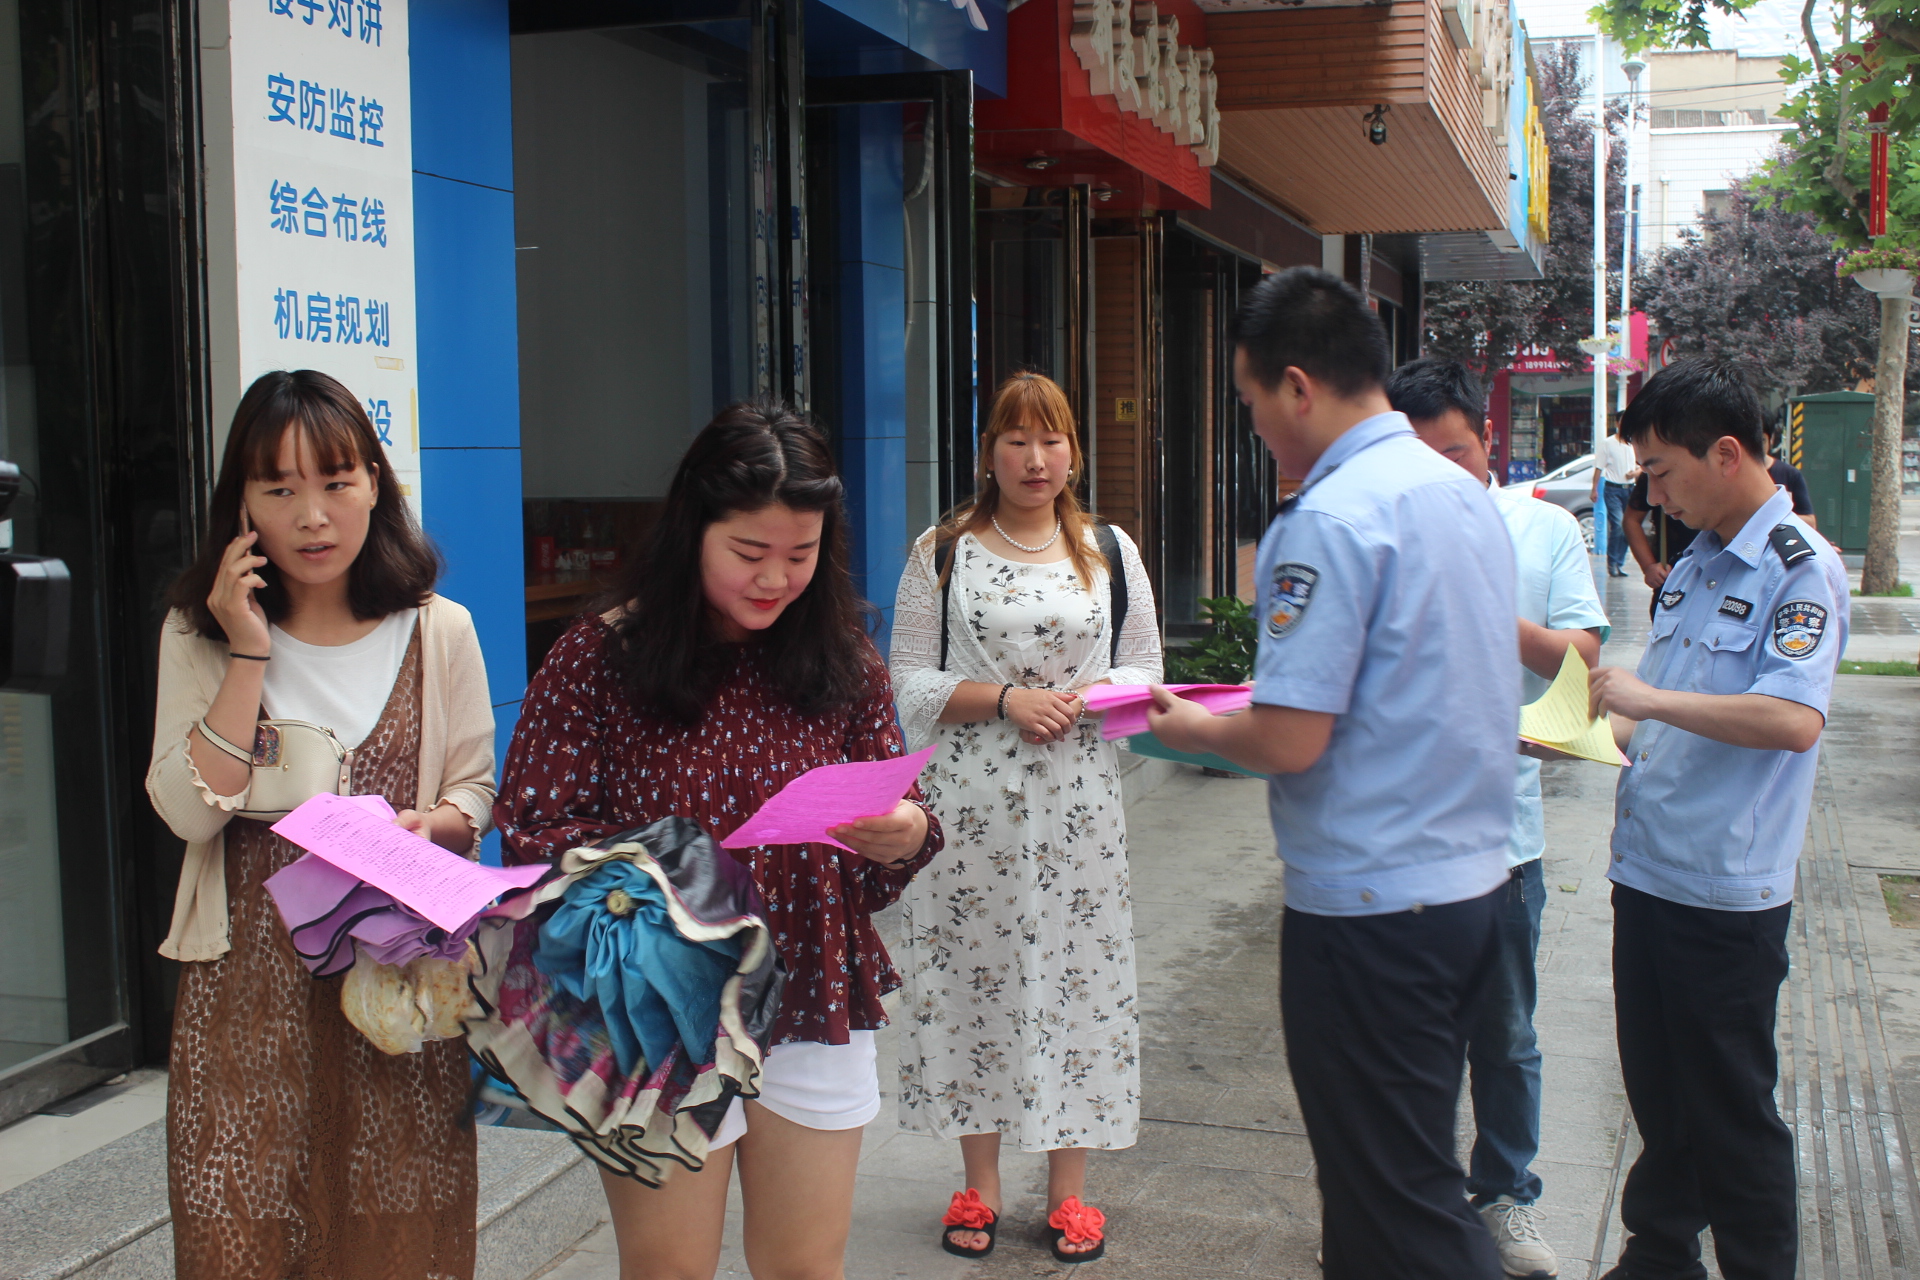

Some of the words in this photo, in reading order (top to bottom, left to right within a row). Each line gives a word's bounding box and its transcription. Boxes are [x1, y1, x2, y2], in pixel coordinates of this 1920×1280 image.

[267, 71, 385, 148] 安防监控
[269, 179, 387, 248] 综合布线
[273, 287, 390, 348] 机房规划
[1777, 603, 1825, 619] 中华人民共和国
